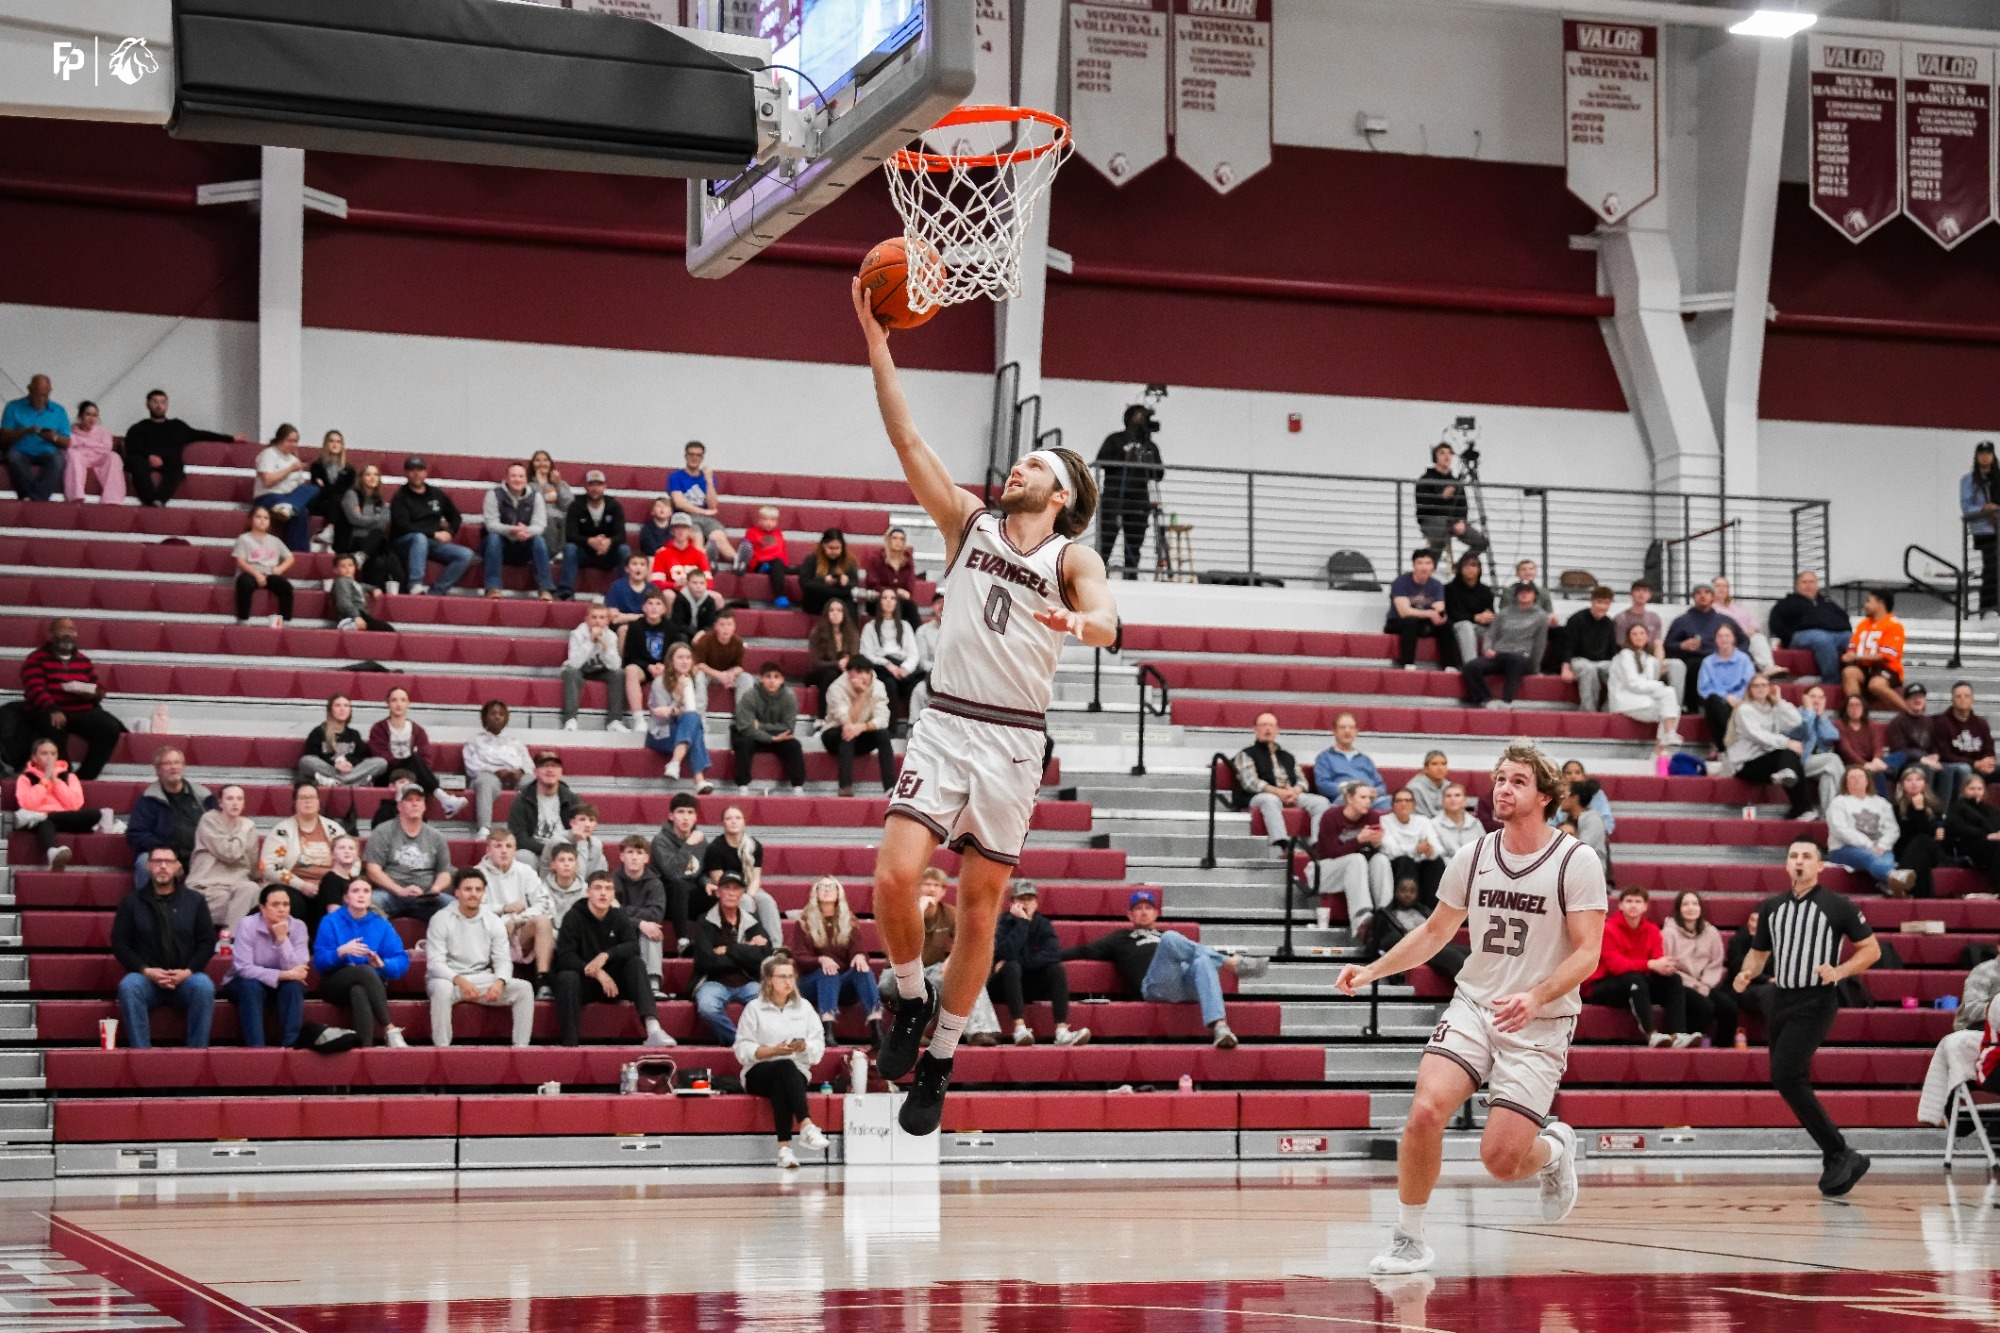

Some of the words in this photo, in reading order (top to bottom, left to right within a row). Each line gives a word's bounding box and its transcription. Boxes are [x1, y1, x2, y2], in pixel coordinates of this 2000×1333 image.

[1086, 9, 1151, 24] WOMEN'S
[1075, 19, 1161, 37] VOLLEYBALL
[1191, 19, 1254, 34] WOMEN'S
[1179, 30, 1264, 47] VOLLEYBALL
[1578, 26, 1641, 51] VALOR
[1580, 57, 1640, 69] WOMEN'S
[1823, 46, 1885, 72] VALOR
[1916, 52, 1978, 78] VALOR
[1077, 70, 1110, 80] 2014
[1568, 66, 1649, 82] VOLLEYBALL
[1835, 75, 1874, 87] MEN'S
[1813, 85, 1894, 101] BASKETBALL
[1928, 83, 1967, 95] MEN'S
[1906, 91, 1988, 108] BASKETBALL
[964, 546, 1050, 598] EVANGEL
[983, 584, 1012, 635] 0
[1856, 630, 1883, 658] 15
[1477, 888, 1547, 915] EVANGEL
[1482, 915, 1529, 957] 23
